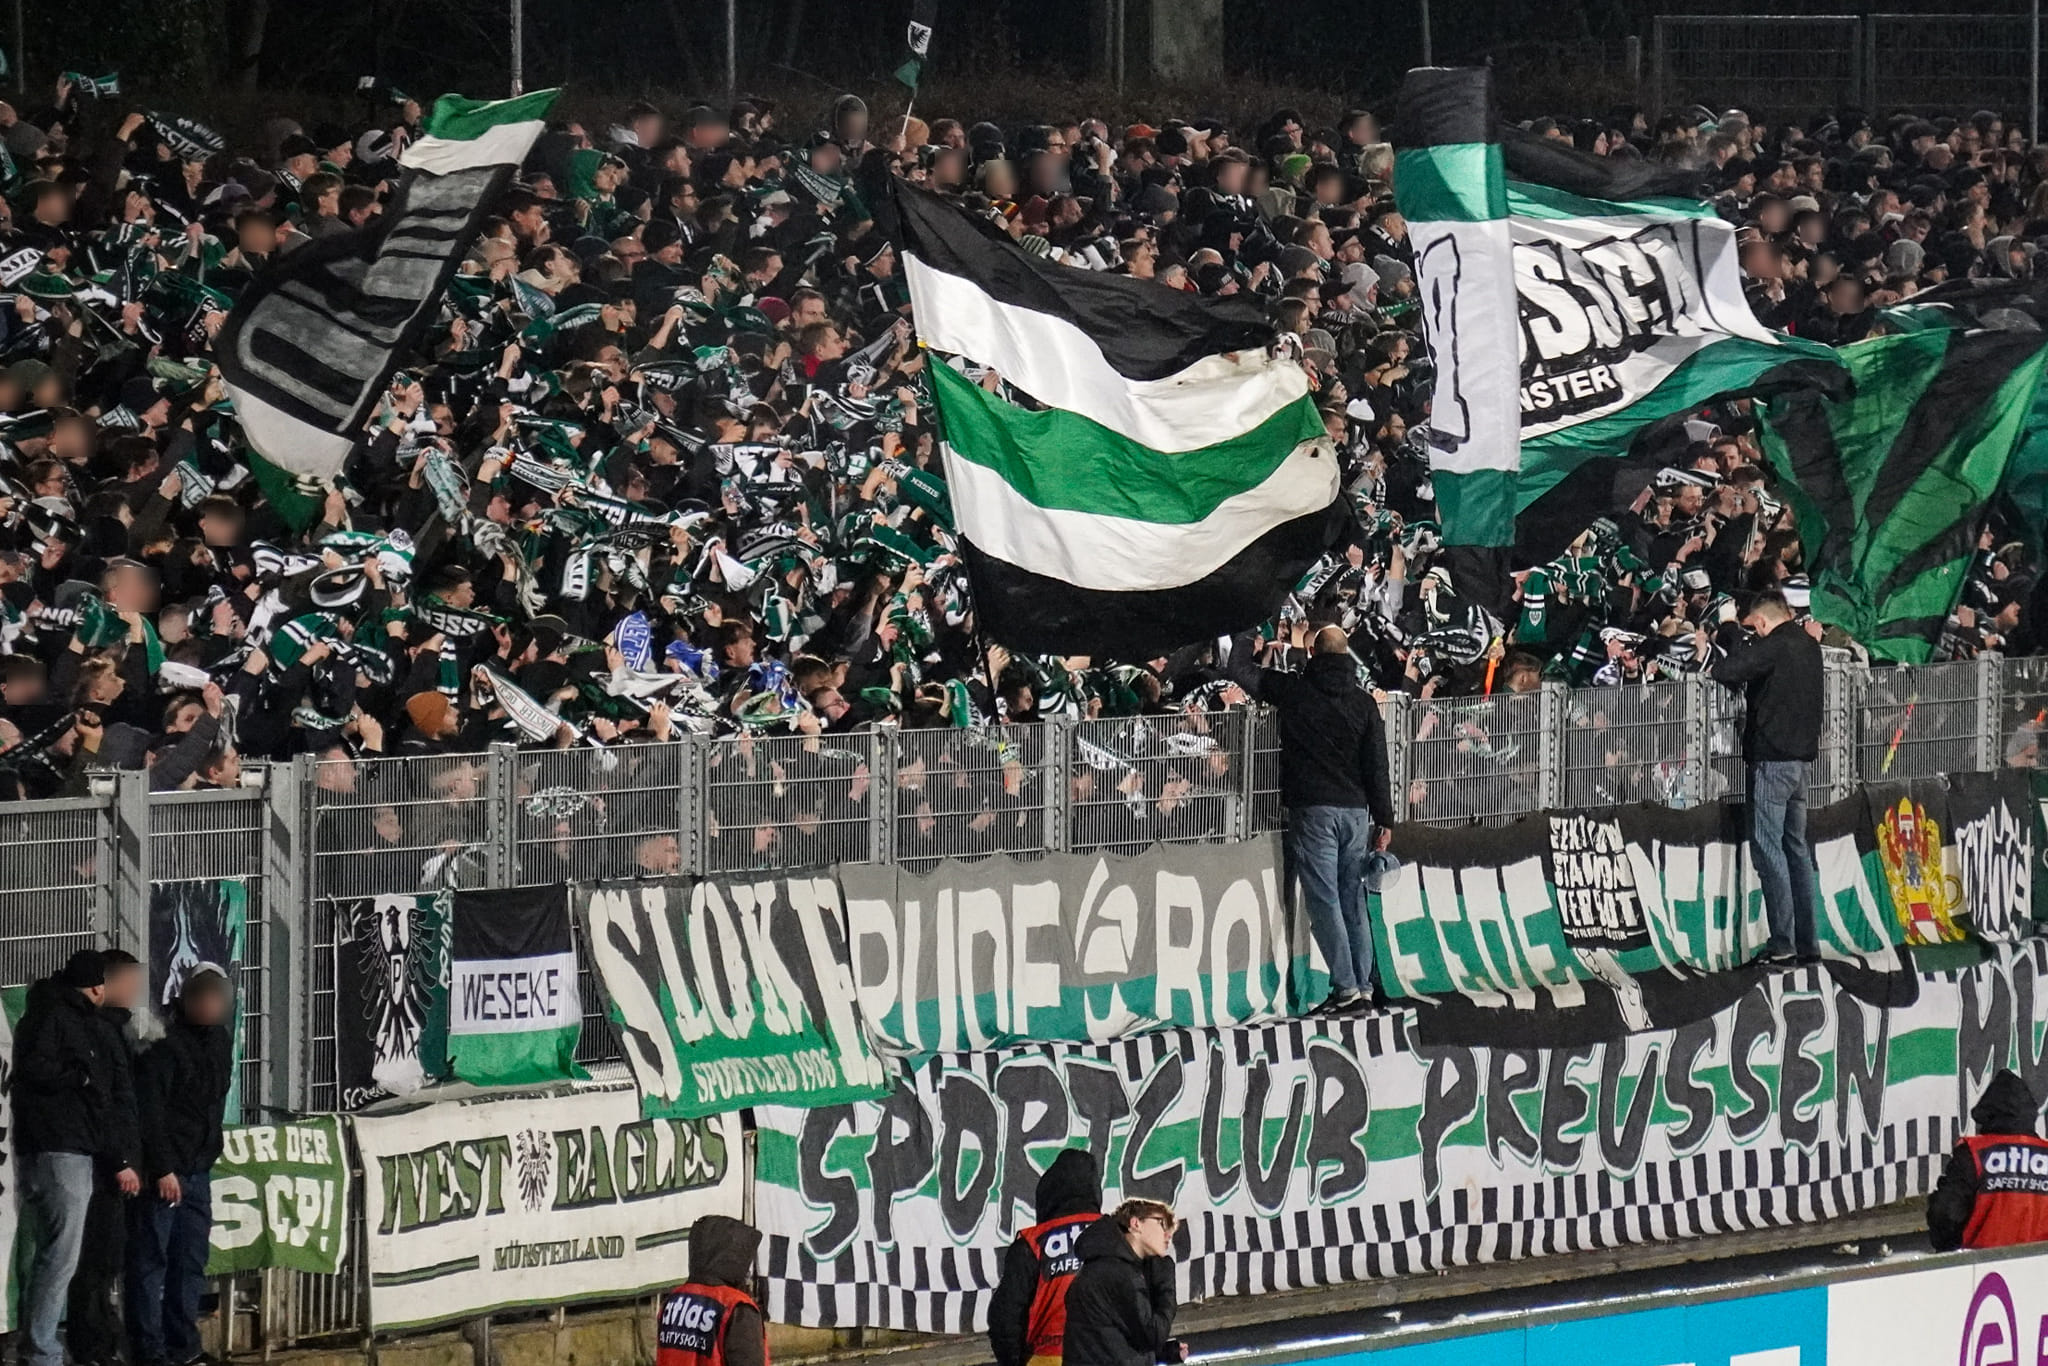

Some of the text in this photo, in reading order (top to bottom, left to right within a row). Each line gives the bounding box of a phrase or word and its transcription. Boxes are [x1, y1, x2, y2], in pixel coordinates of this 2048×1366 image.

[1556, 887, 1640, 929] VERBOT
[461, 968, 559, 1022] WESEKE
[792, 1047, 837, 1092] 1906
[1403, 978, 1893, 1202] PREUSSEN
[216, 1125, 333, 1165] UR DER
[376, 1112, 729, 1235] WEST EAGLES
[1986, 1176, 2029, 1191] SAFETY
[208, 1174, 335, 1252] SCP!
[492, 1234, 625, 1272] MÜNSTERLAND
[1050, 1260, 1084, 1276] SAFE
